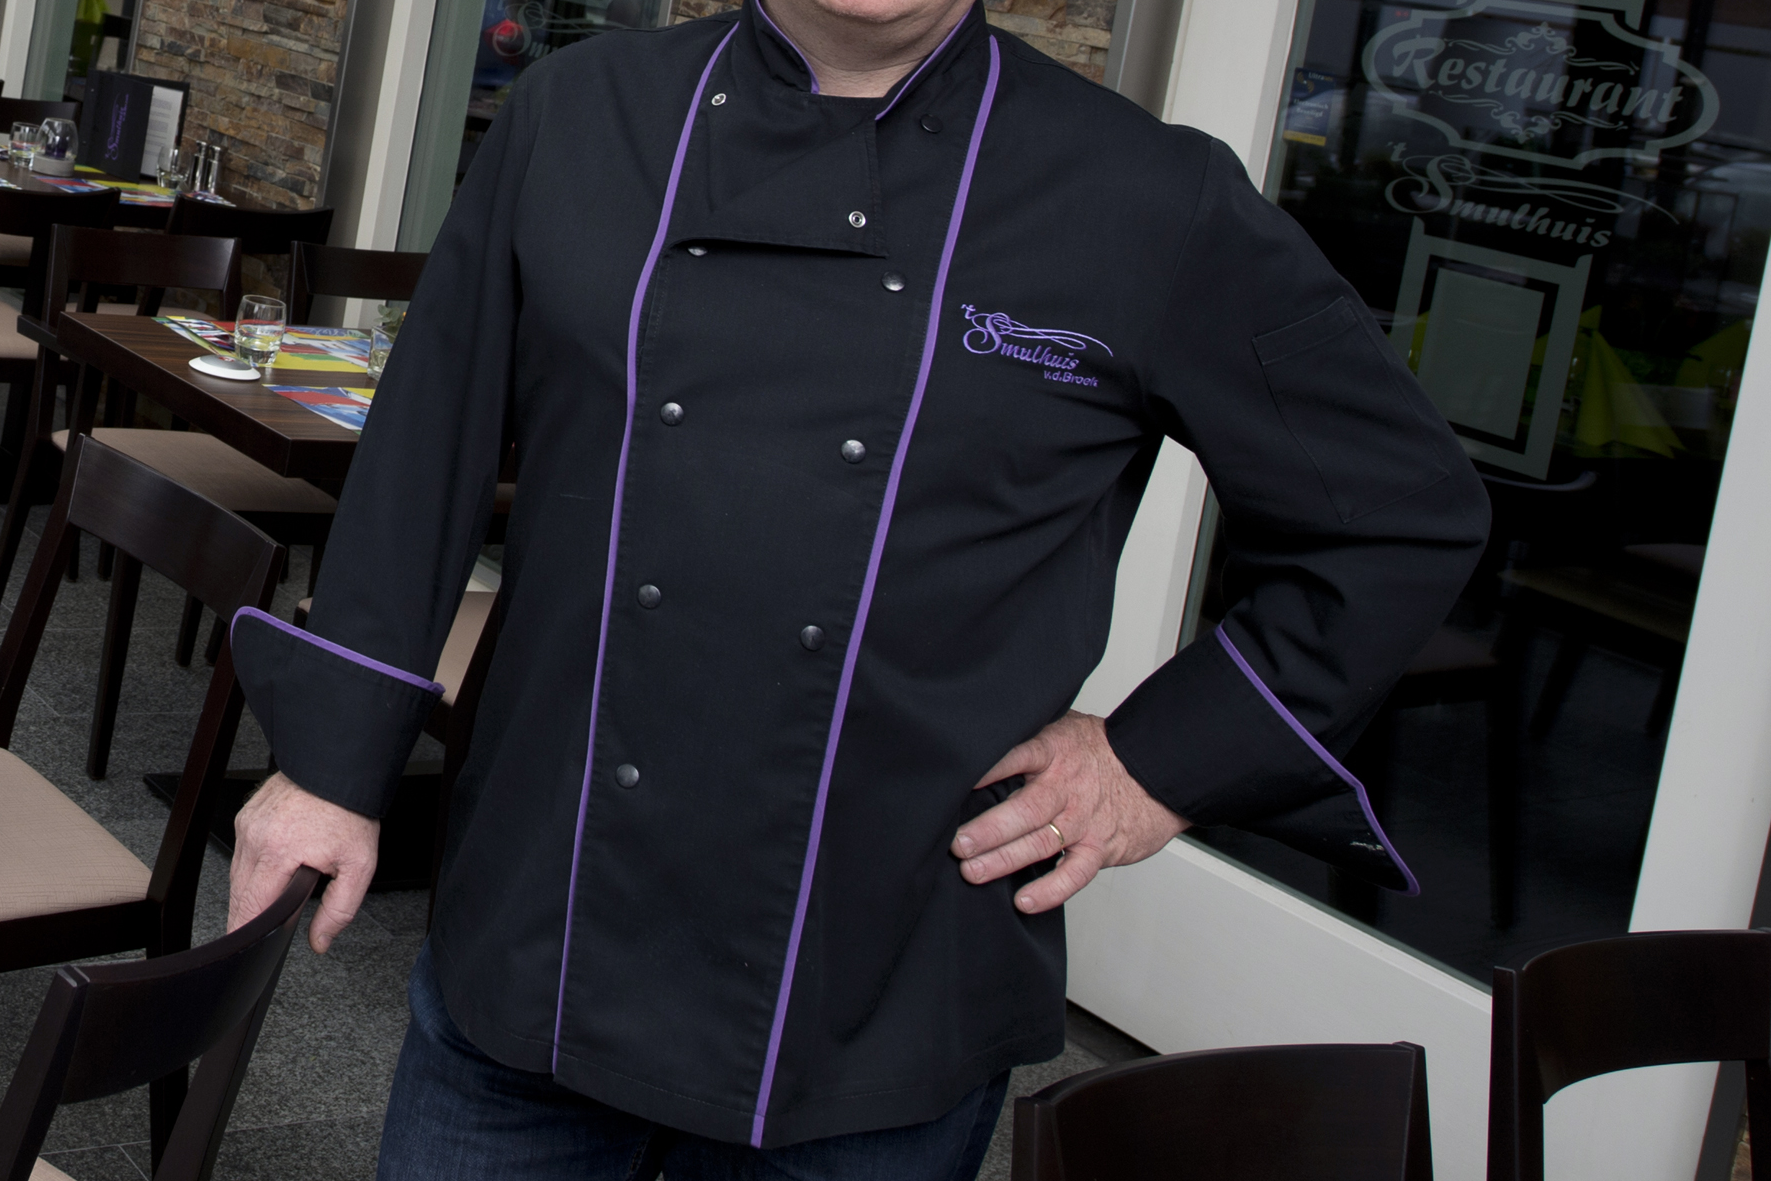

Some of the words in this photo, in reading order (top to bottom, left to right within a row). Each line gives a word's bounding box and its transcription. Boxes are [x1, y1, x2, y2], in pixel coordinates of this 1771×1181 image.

[1392, 34, 1685, 125] Restaurant
[1384, 154, 1616, 248] Smulhuis
[963, 313, 1082, 370] Smulhuis
